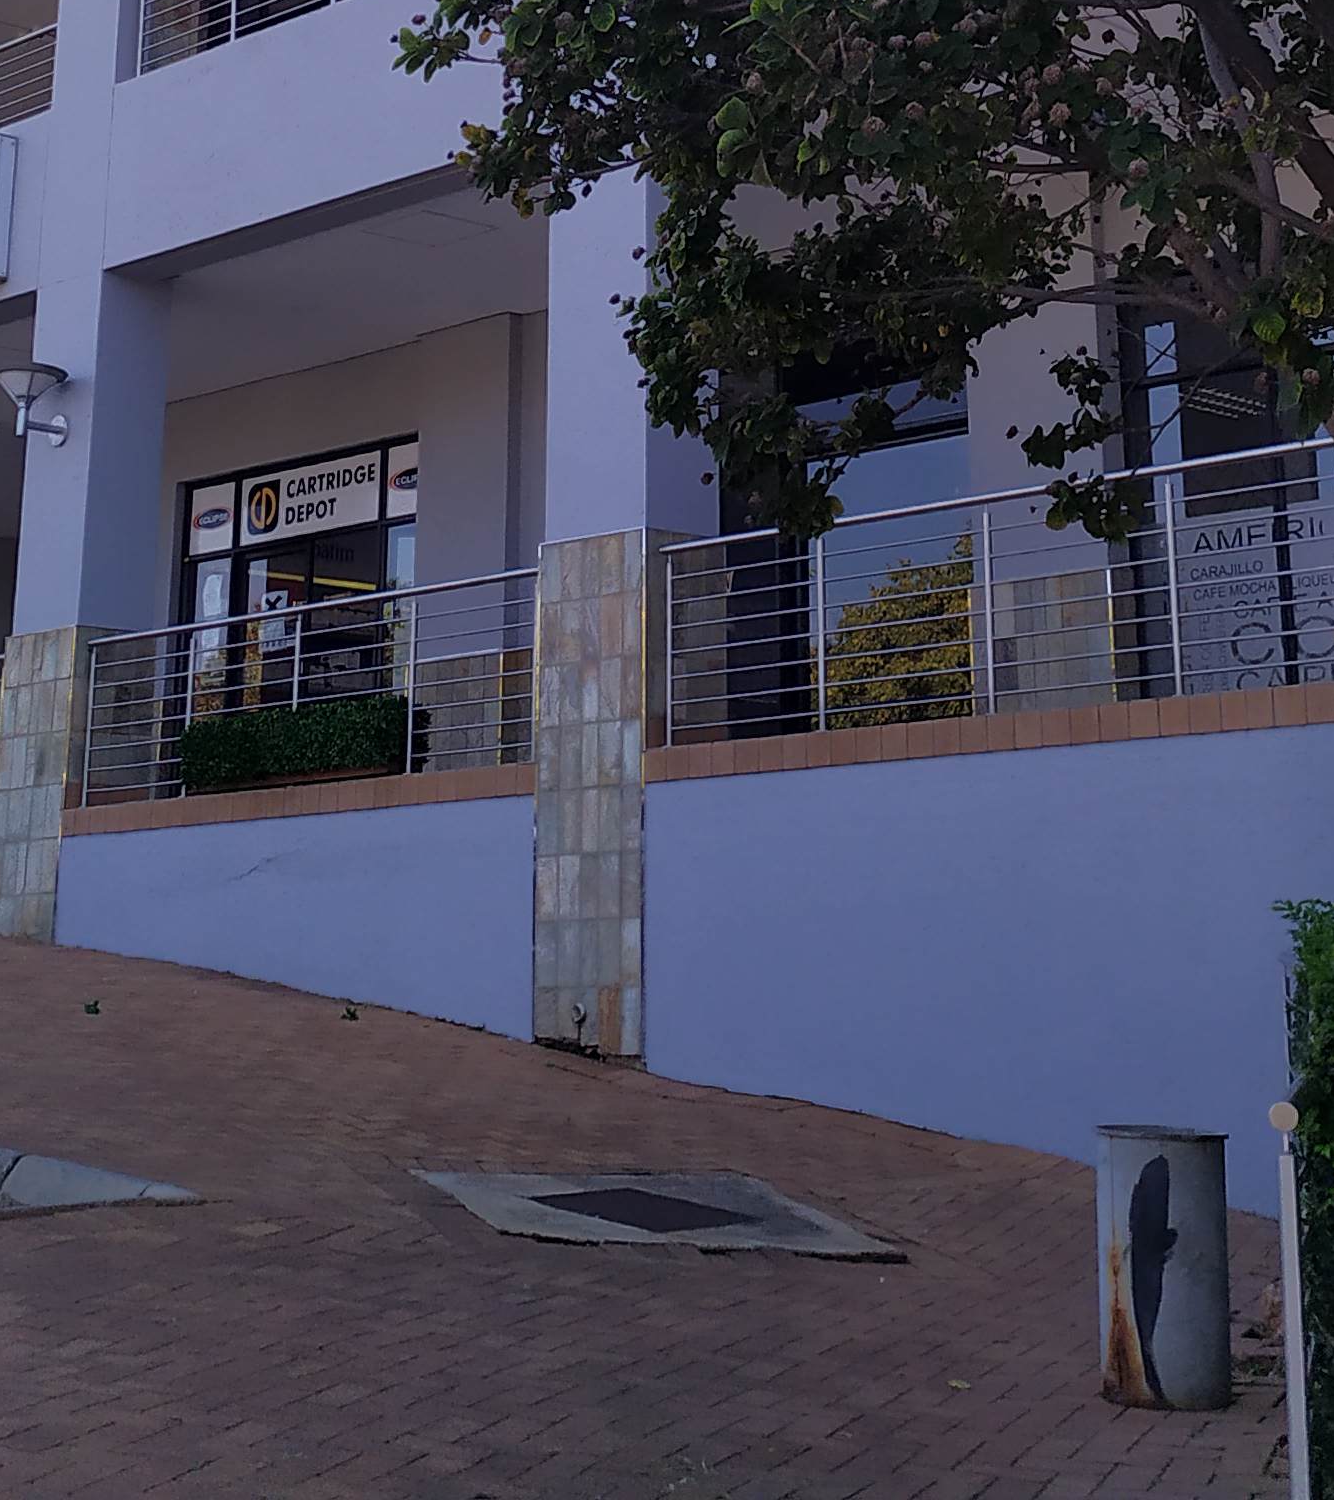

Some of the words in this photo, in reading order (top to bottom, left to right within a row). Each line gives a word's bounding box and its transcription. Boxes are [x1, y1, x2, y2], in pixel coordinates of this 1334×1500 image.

[286, 462, 376, 498] CARTRIDGE
[285, 497, 337, 525] DEPOT
[1190, 560, 1263, 582] CARAJILLO
[1193, 586, 1227, 601] CAFE
[1229, 579, 1277, 597] MOCHA
